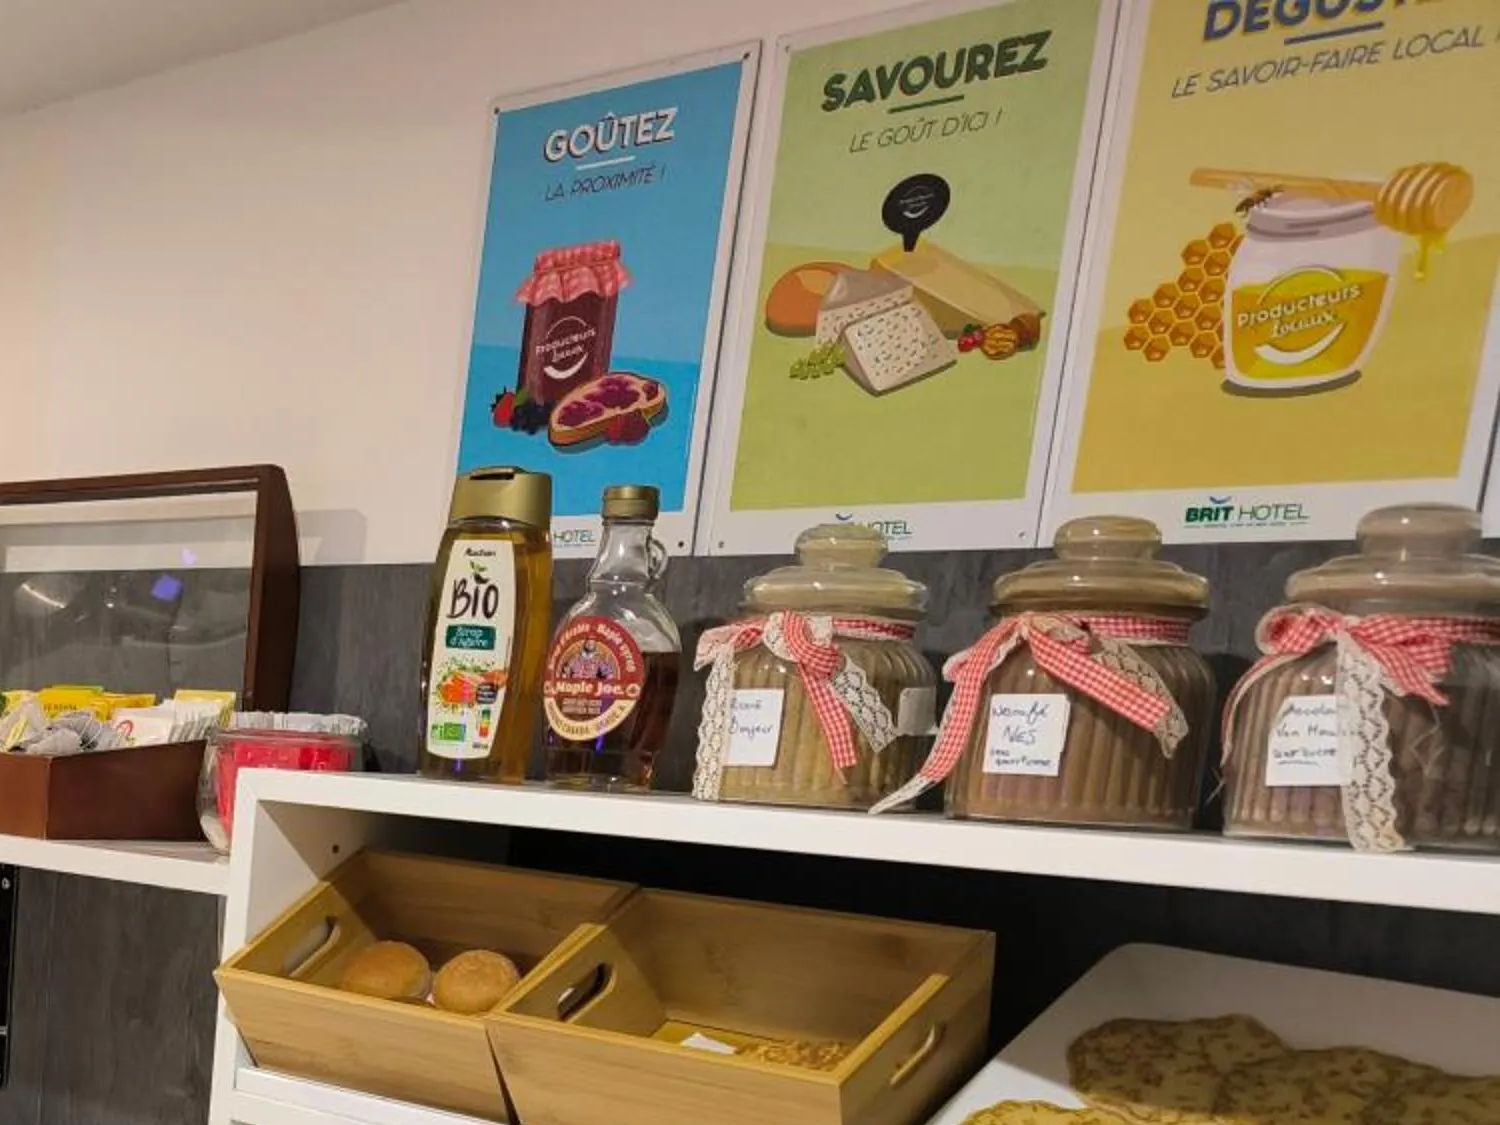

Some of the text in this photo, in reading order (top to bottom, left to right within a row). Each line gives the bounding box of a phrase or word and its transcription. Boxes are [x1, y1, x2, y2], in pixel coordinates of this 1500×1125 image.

[822, 30, 1052, 112] SAVOUREZ
[1172, 25, 1485, 98] LE SAVOIR-FAIRE LOCAL
[544, 106, 679, 162] GOÛTEZ
[849, 132, 872, 153] LE
[878, 117, 935, 148] GOÛT
[545, 183, 565, 201] LA
[570, 164, 657, 196] PROXIMITÉ
[1237, 284, 1362, 328] Producteurs
[1184, 503, 1311, 523] BRIT HOTEL
